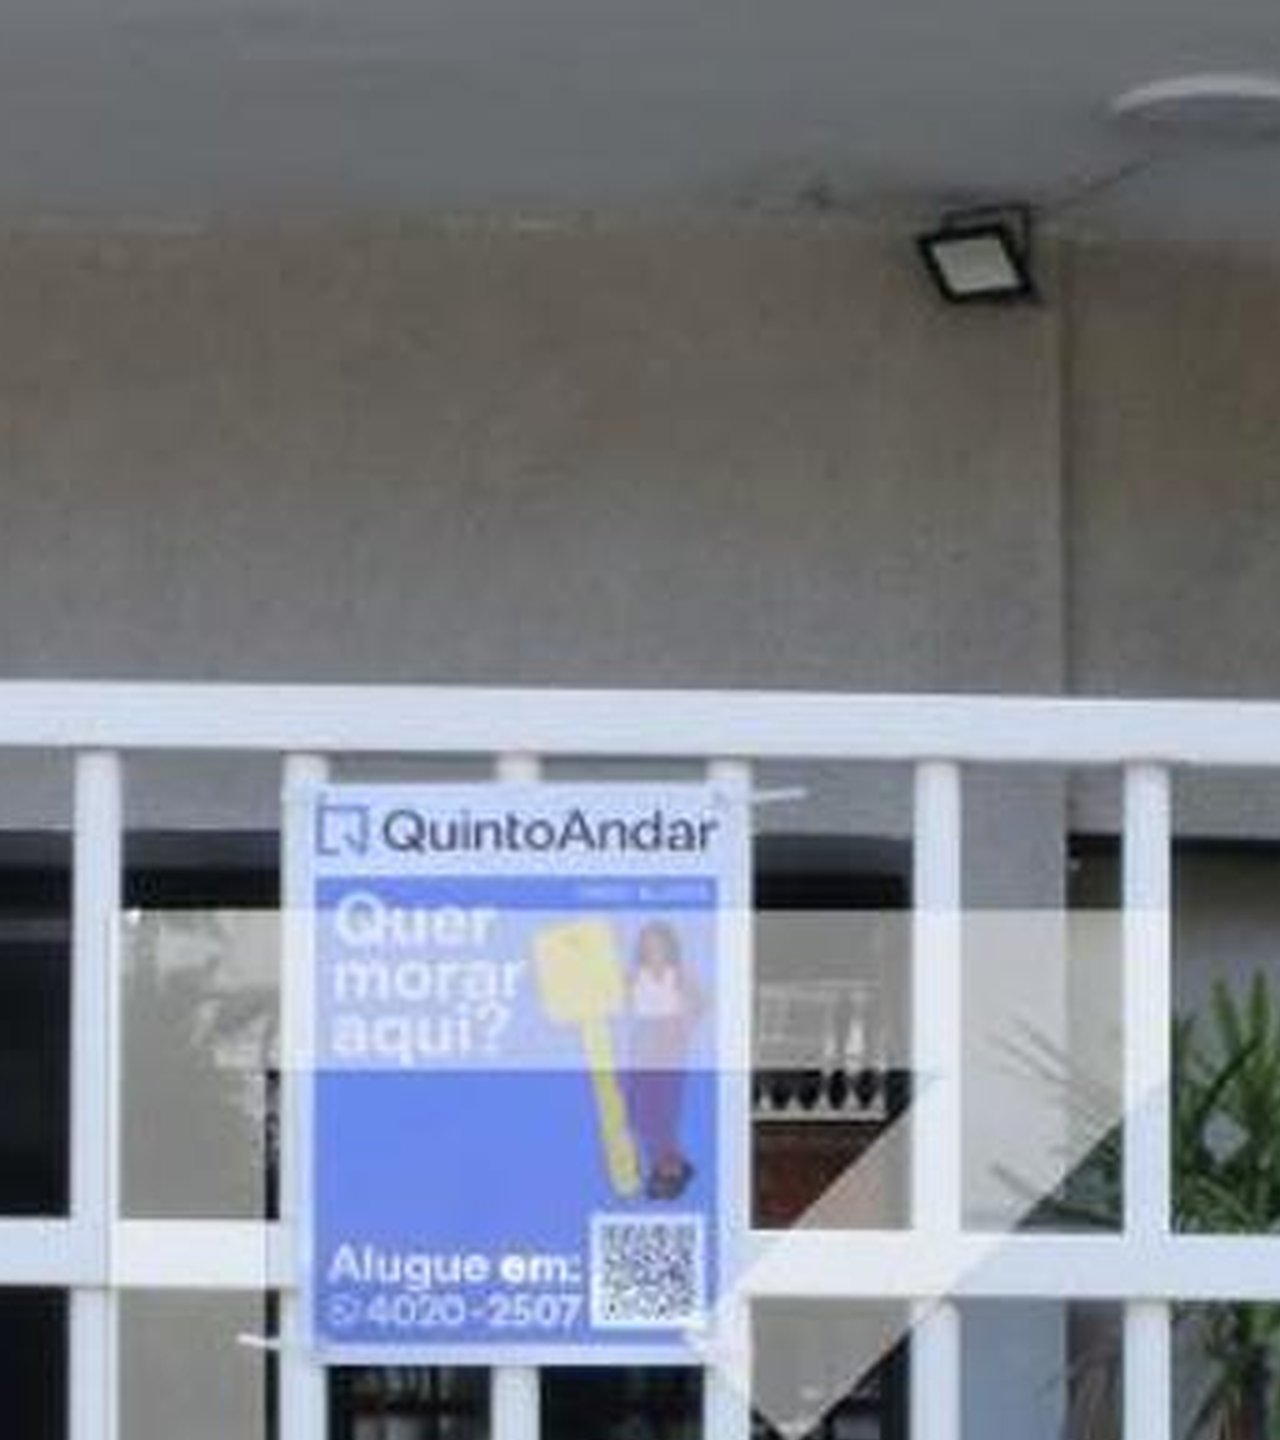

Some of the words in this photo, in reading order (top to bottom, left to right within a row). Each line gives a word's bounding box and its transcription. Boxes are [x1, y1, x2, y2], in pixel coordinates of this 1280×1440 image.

[382, 809, 717, 854] QuintoAndar
[333, 890, 499, 948] Quer
[334, 962, 520, 1001] morar
[332, 1002, 510, 1064] aqui?
[328, 1243, 490, 1290] Alugue
[500, 1254, 581, 1282] em:
